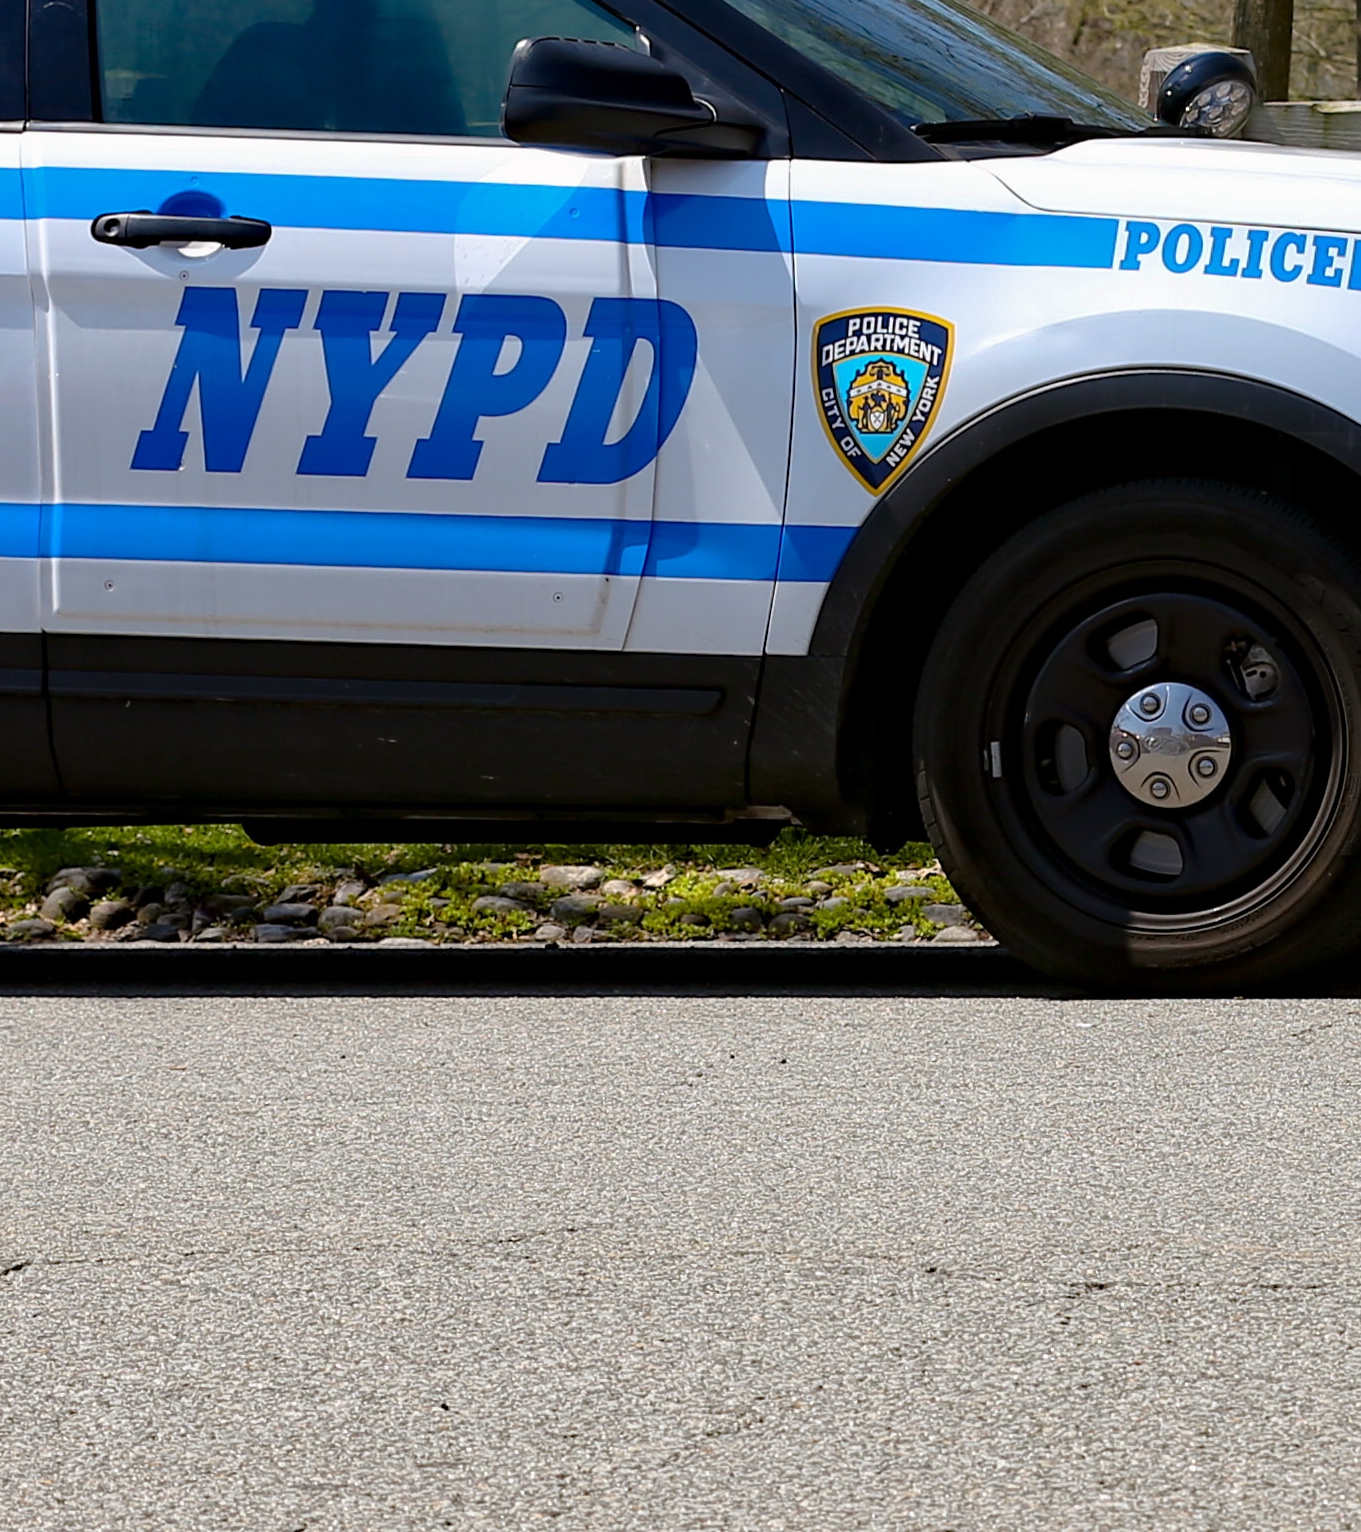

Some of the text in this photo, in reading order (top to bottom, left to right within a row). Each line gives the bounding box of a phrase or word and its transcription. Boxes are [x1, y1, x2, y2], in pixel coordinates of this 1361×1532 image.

[1119, 220, 1349, 289] POLICE
[821, 333, 943, 367] DEPARTMENT
[848, 316, 922, 339] POLICE
[130, 286, 698, 485] NYPD
[821, 387, 862, 458] CITY OF
[885, 375, 940, 468] NEW YORK
